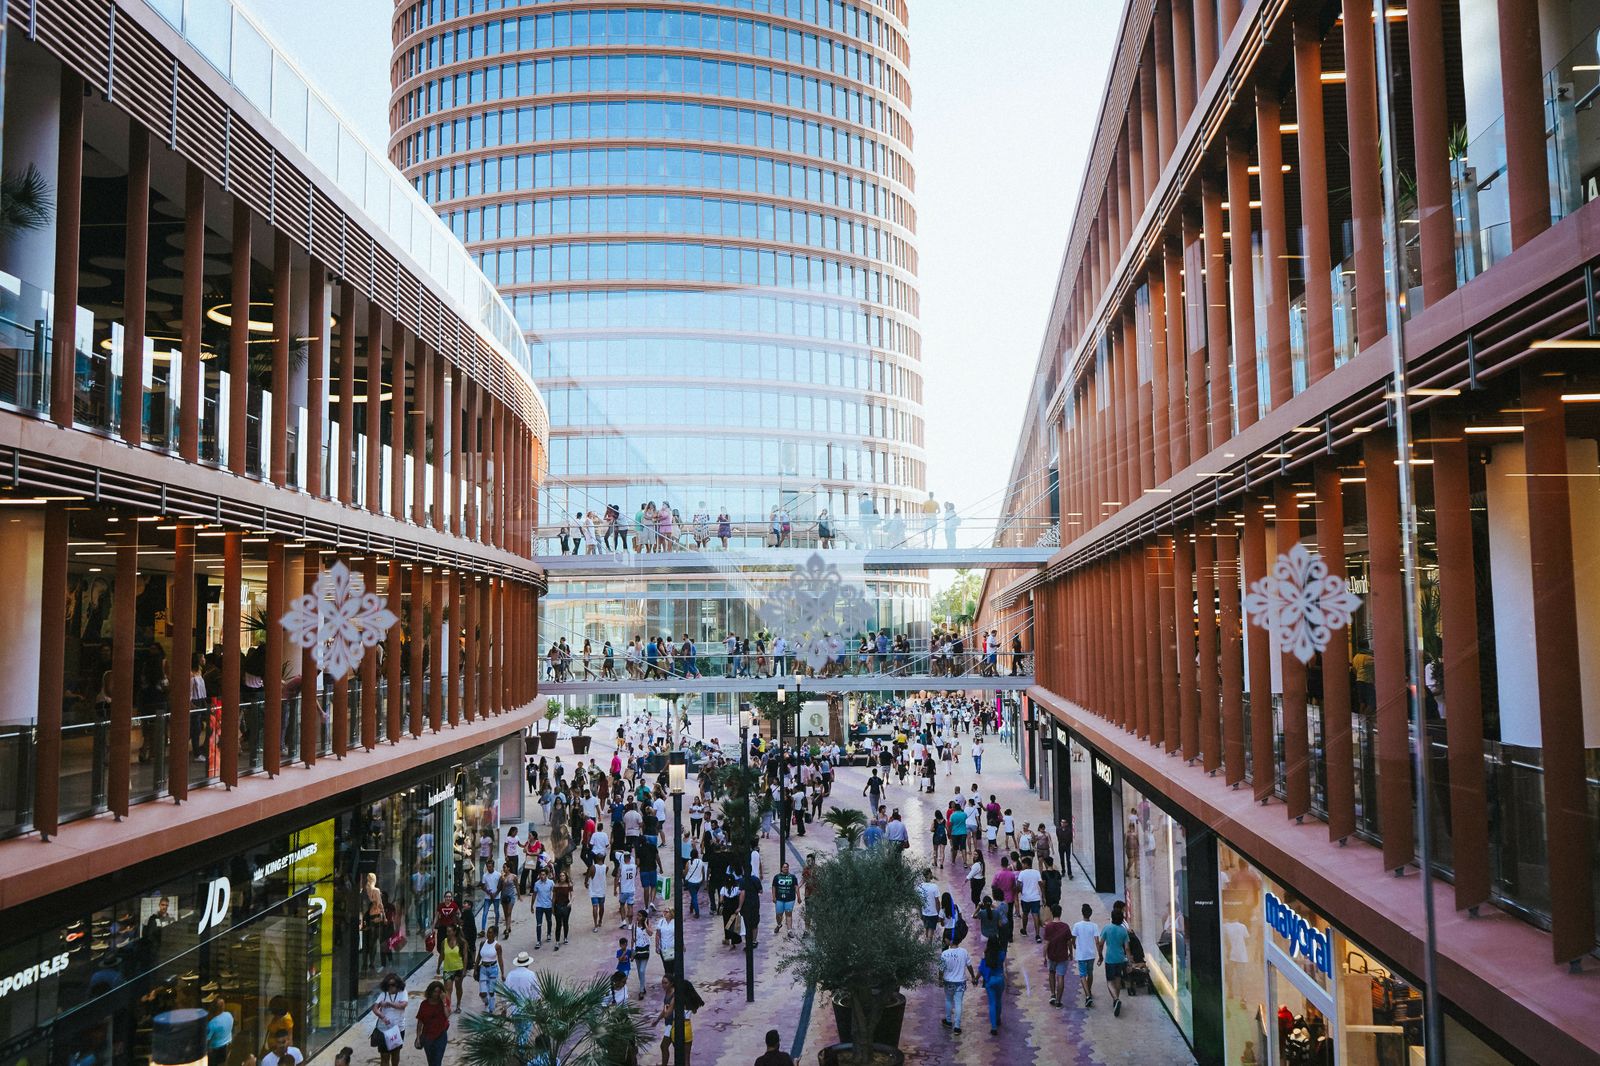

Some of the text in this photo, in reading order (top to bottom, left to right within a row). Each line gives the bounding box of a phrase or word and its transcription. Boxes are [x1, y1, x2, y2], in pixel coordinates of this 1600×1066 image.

[264, 858, 281, 877] KING
[626, 872, 633, 880] 16
[198, 876, 231, 935] JD
[1265, 892, 1332, 979] mayoral
